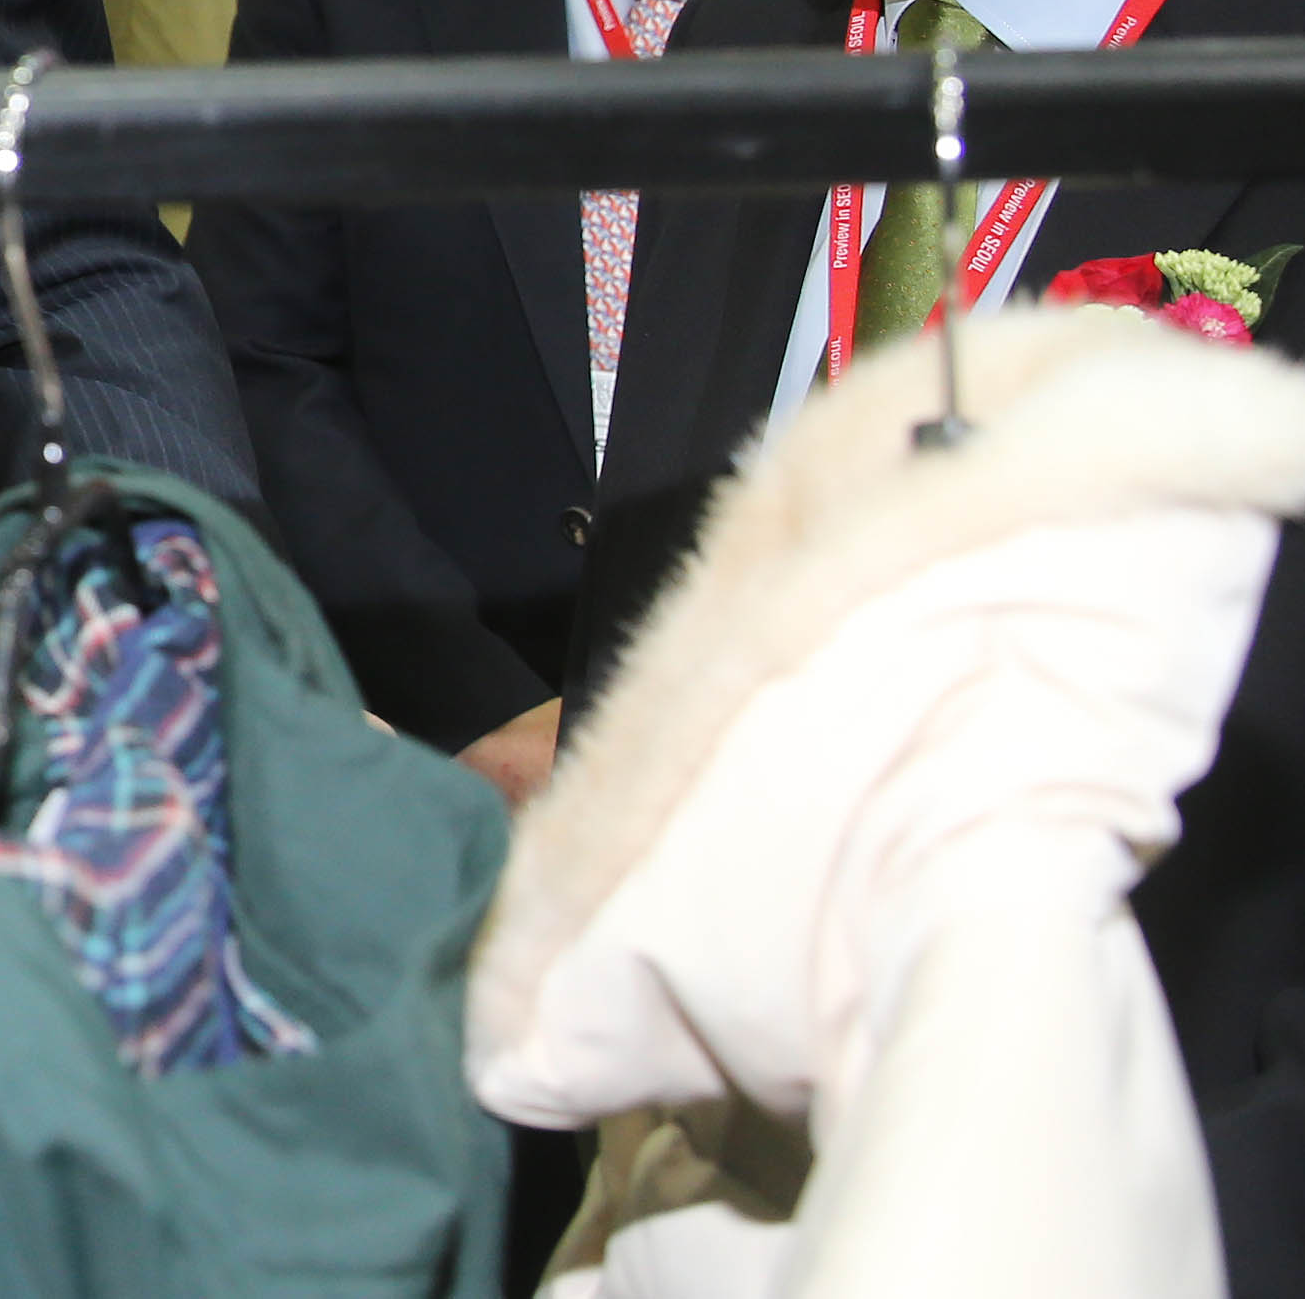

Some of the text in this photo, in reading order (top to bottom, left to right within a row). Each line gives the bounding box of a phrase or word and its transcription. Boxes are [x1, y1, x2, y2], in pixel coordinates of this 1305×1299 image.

[848, 10, 867, 48] SEOUL
[1109, 16, 1138, 48] Previ
[833, 183, 852, 270] Preview in SEO
[991, 221, 1010, 236] in
[967, 234, 1001, 273] SEOUL
